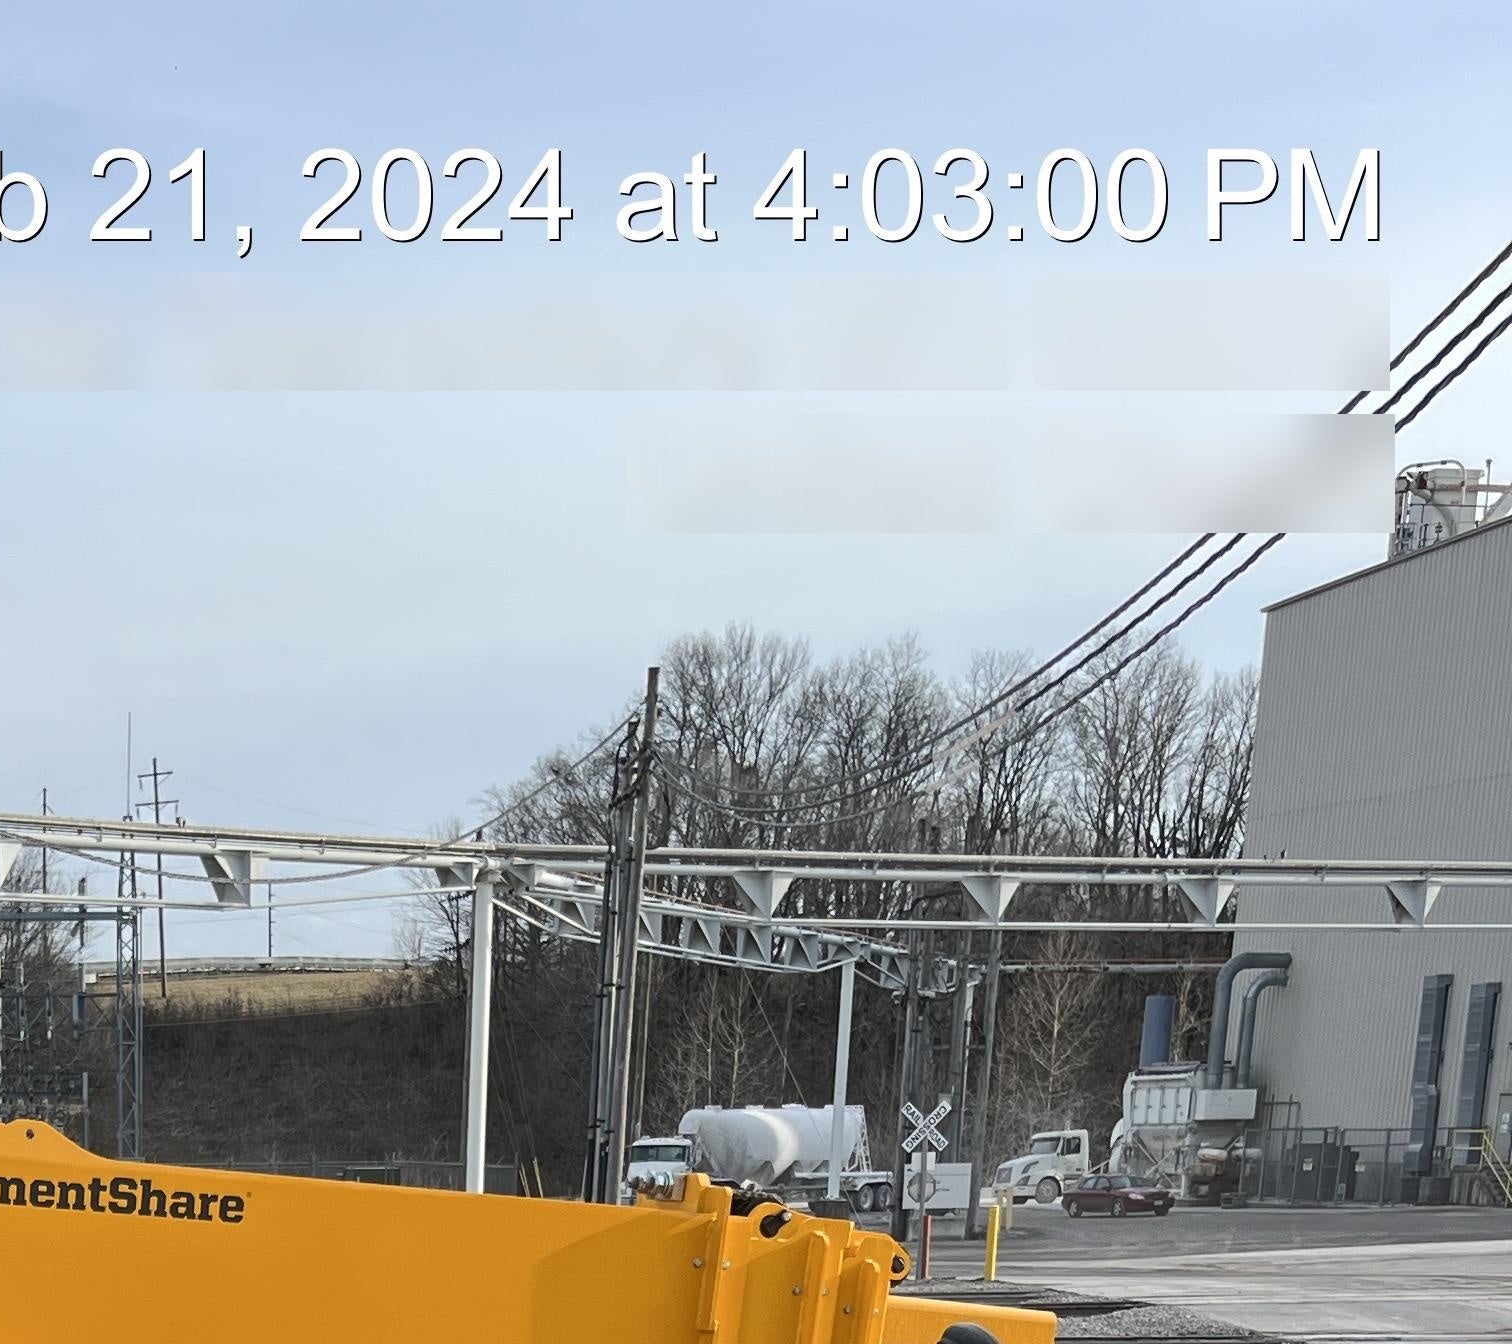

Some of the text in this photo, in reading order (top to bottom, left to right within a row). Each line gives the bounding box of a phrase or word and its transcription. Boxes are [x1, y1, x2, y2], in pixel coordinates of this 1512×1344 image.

[903, 1104, 946, 1149] RAIL ROAD
[905, 1105, 948, 1149] CROSSING
